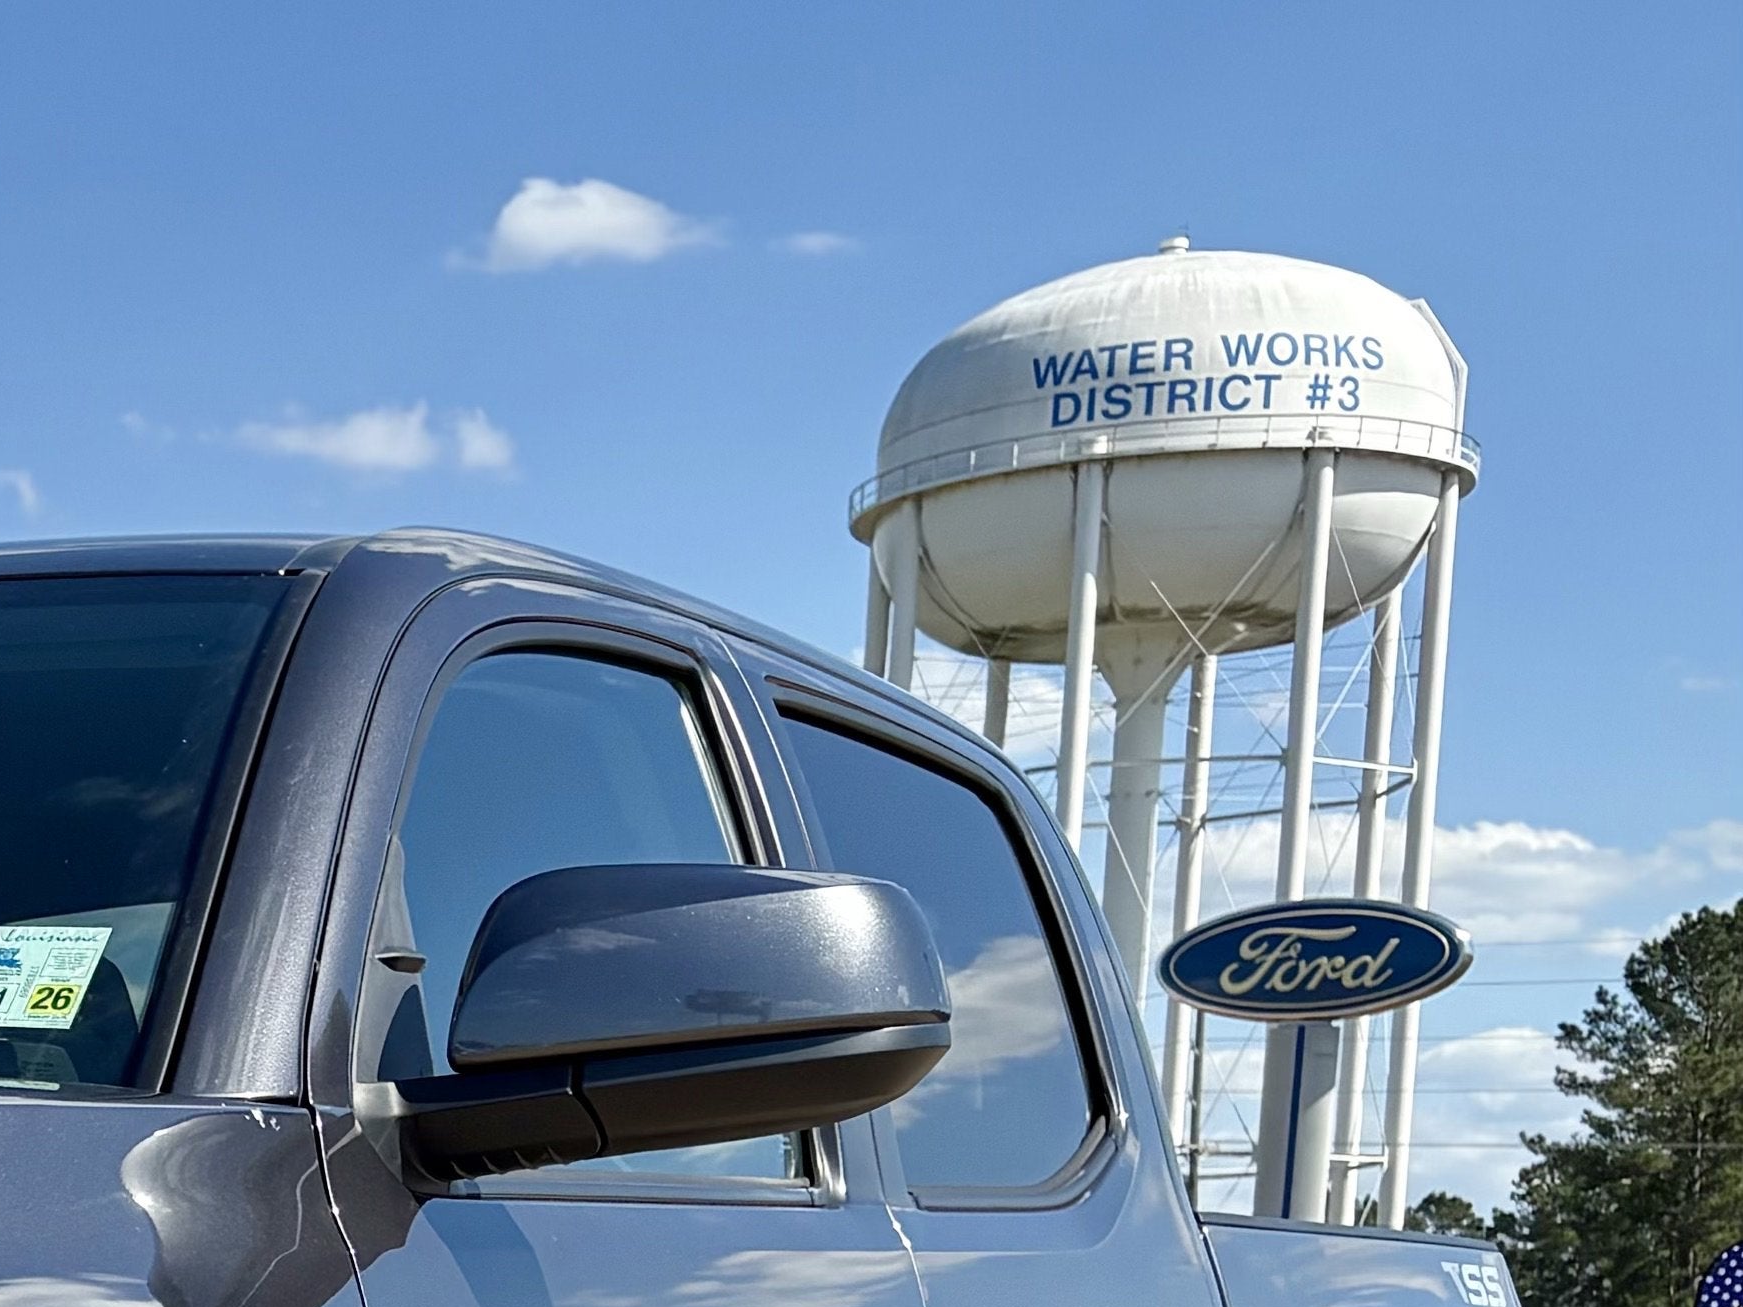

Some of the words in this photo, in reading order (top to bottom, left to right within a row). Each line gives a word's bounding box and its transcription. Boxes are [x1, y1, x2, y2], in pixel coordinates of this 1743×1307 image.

[1032, 336, 1194, 390] WATER
[1220, 331, 1384, 371] WORKS
[1050, 373, 1282, 428] DISTRICT
[1306, 375, 1360, 411] #3
[0, 928, 100, 943] Louisiana
[1219, 925, 1400, 995] Ford
[30, 986, 74, 1011] 26
